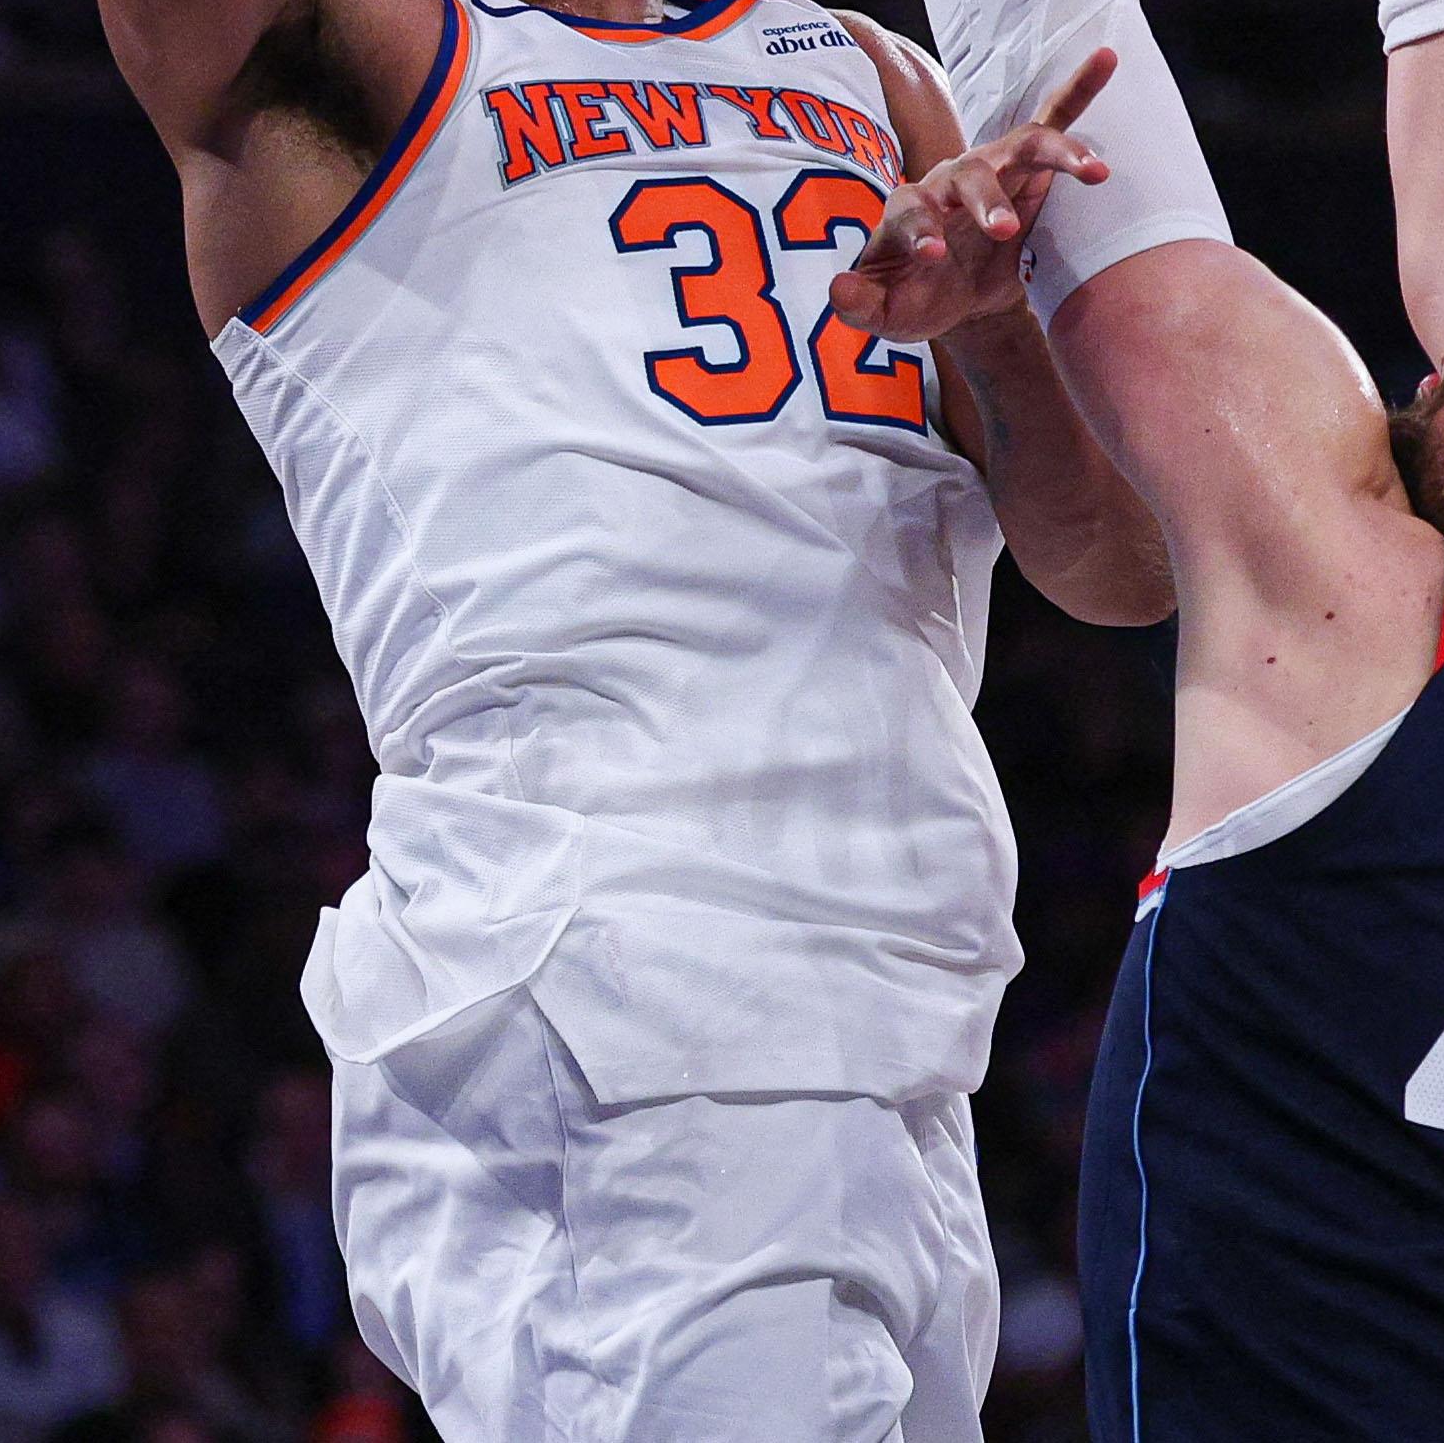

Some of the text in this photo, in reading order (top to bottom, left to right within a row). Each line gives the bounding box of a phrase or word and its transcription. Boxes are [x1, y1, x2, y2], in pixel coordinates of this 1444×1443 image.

[762, 21, 831, 36] experience
[766, 36, 817, 55] abu
[481, 80, 711, 191] NEW
[609, 169, 928, 437] 32
